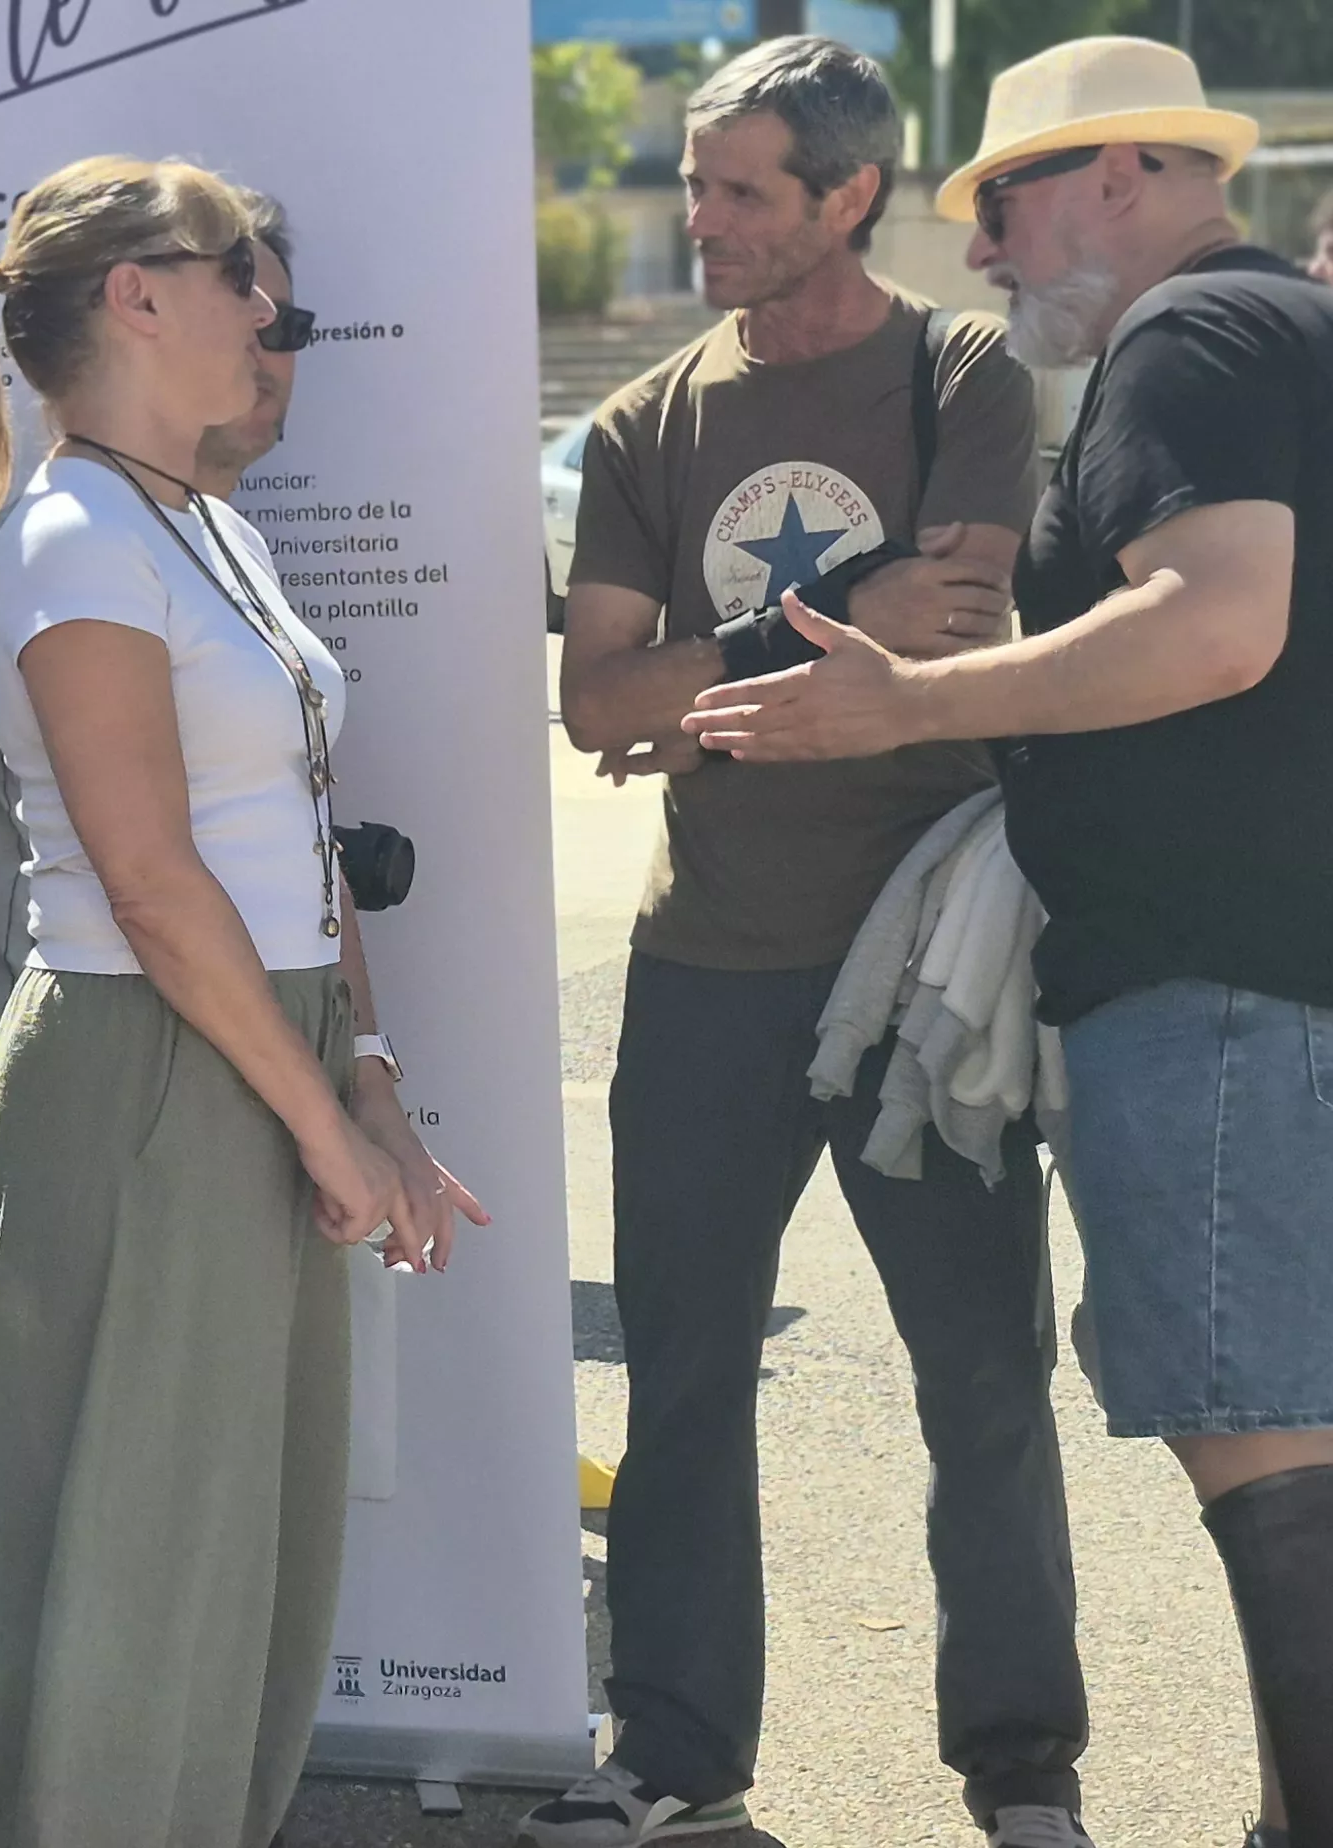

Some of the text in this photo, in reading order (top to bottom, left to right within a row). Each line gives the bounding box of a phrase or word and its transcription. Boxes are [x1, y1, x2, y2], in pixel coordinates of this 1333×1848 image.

[391, 324, 404, 339] o
[257, 502, 352, 523] miembro
[358, 500, 384, 520] de
[391, 500, 412, 519] la
[265, 534, 399, 556] Universitaria
[281, 564, 448, 587] resentantes del
[302, 597, 419, 624] la plantilla
[419, 1106, 440, 1126] la
[379, 1658, 508, 1683] Universidad
[382, 1680, 462, 1700] Zaragoza
